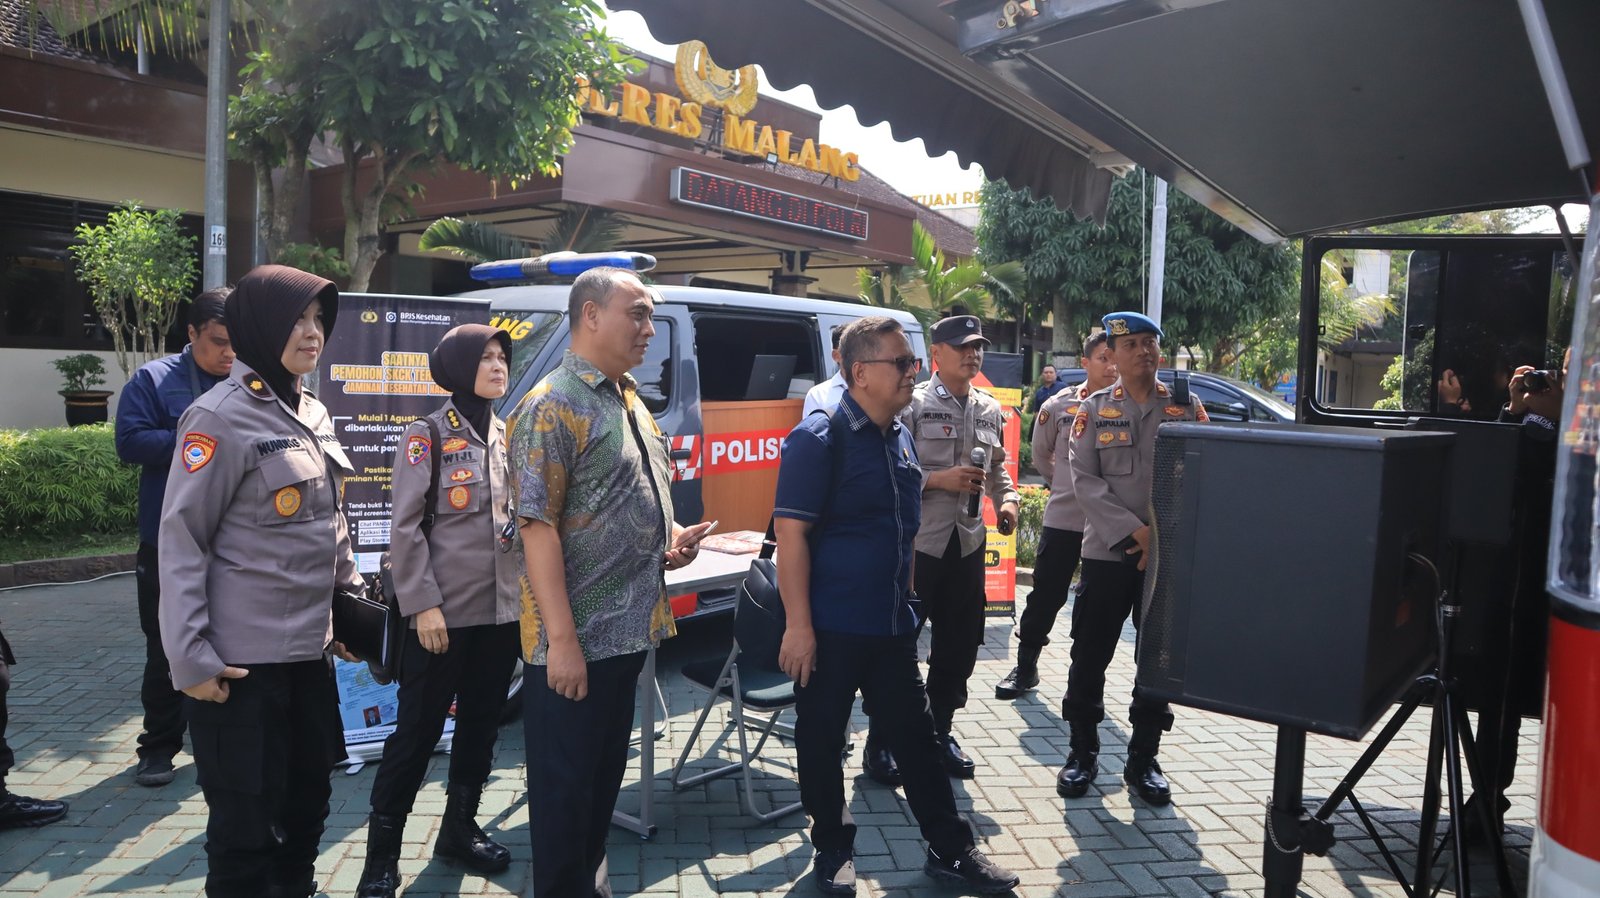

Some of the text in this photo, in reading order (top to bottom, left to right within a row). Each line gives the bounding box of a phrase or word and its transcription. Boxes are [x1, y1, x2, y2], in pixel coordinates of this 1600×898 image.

[724, 114, 860, 182] MALANG
[688, 173, 782, 220] DATANG
[788, 197, 808, 224] DI
[400, 312, 415, 320] BPJS
[416, 313, 451, 322] Kesehatan
[383, 353, 428, 367] SAATNYA
[332, 366, 383, 380] PEMOHON
[385, 368, 413, 381] SKCK
[345, 382, 382, 393] JAMINAN
[384, 382, 428, 394] KESEHATAN
[358, 414, 383, 422] Mulai
[344, 424, 404, 432] diberlakukan
[383, 434, 401, 442] JKN
[353, 444, 398, 454] untuk pen
[443, 451, 473, 464] WIJI
